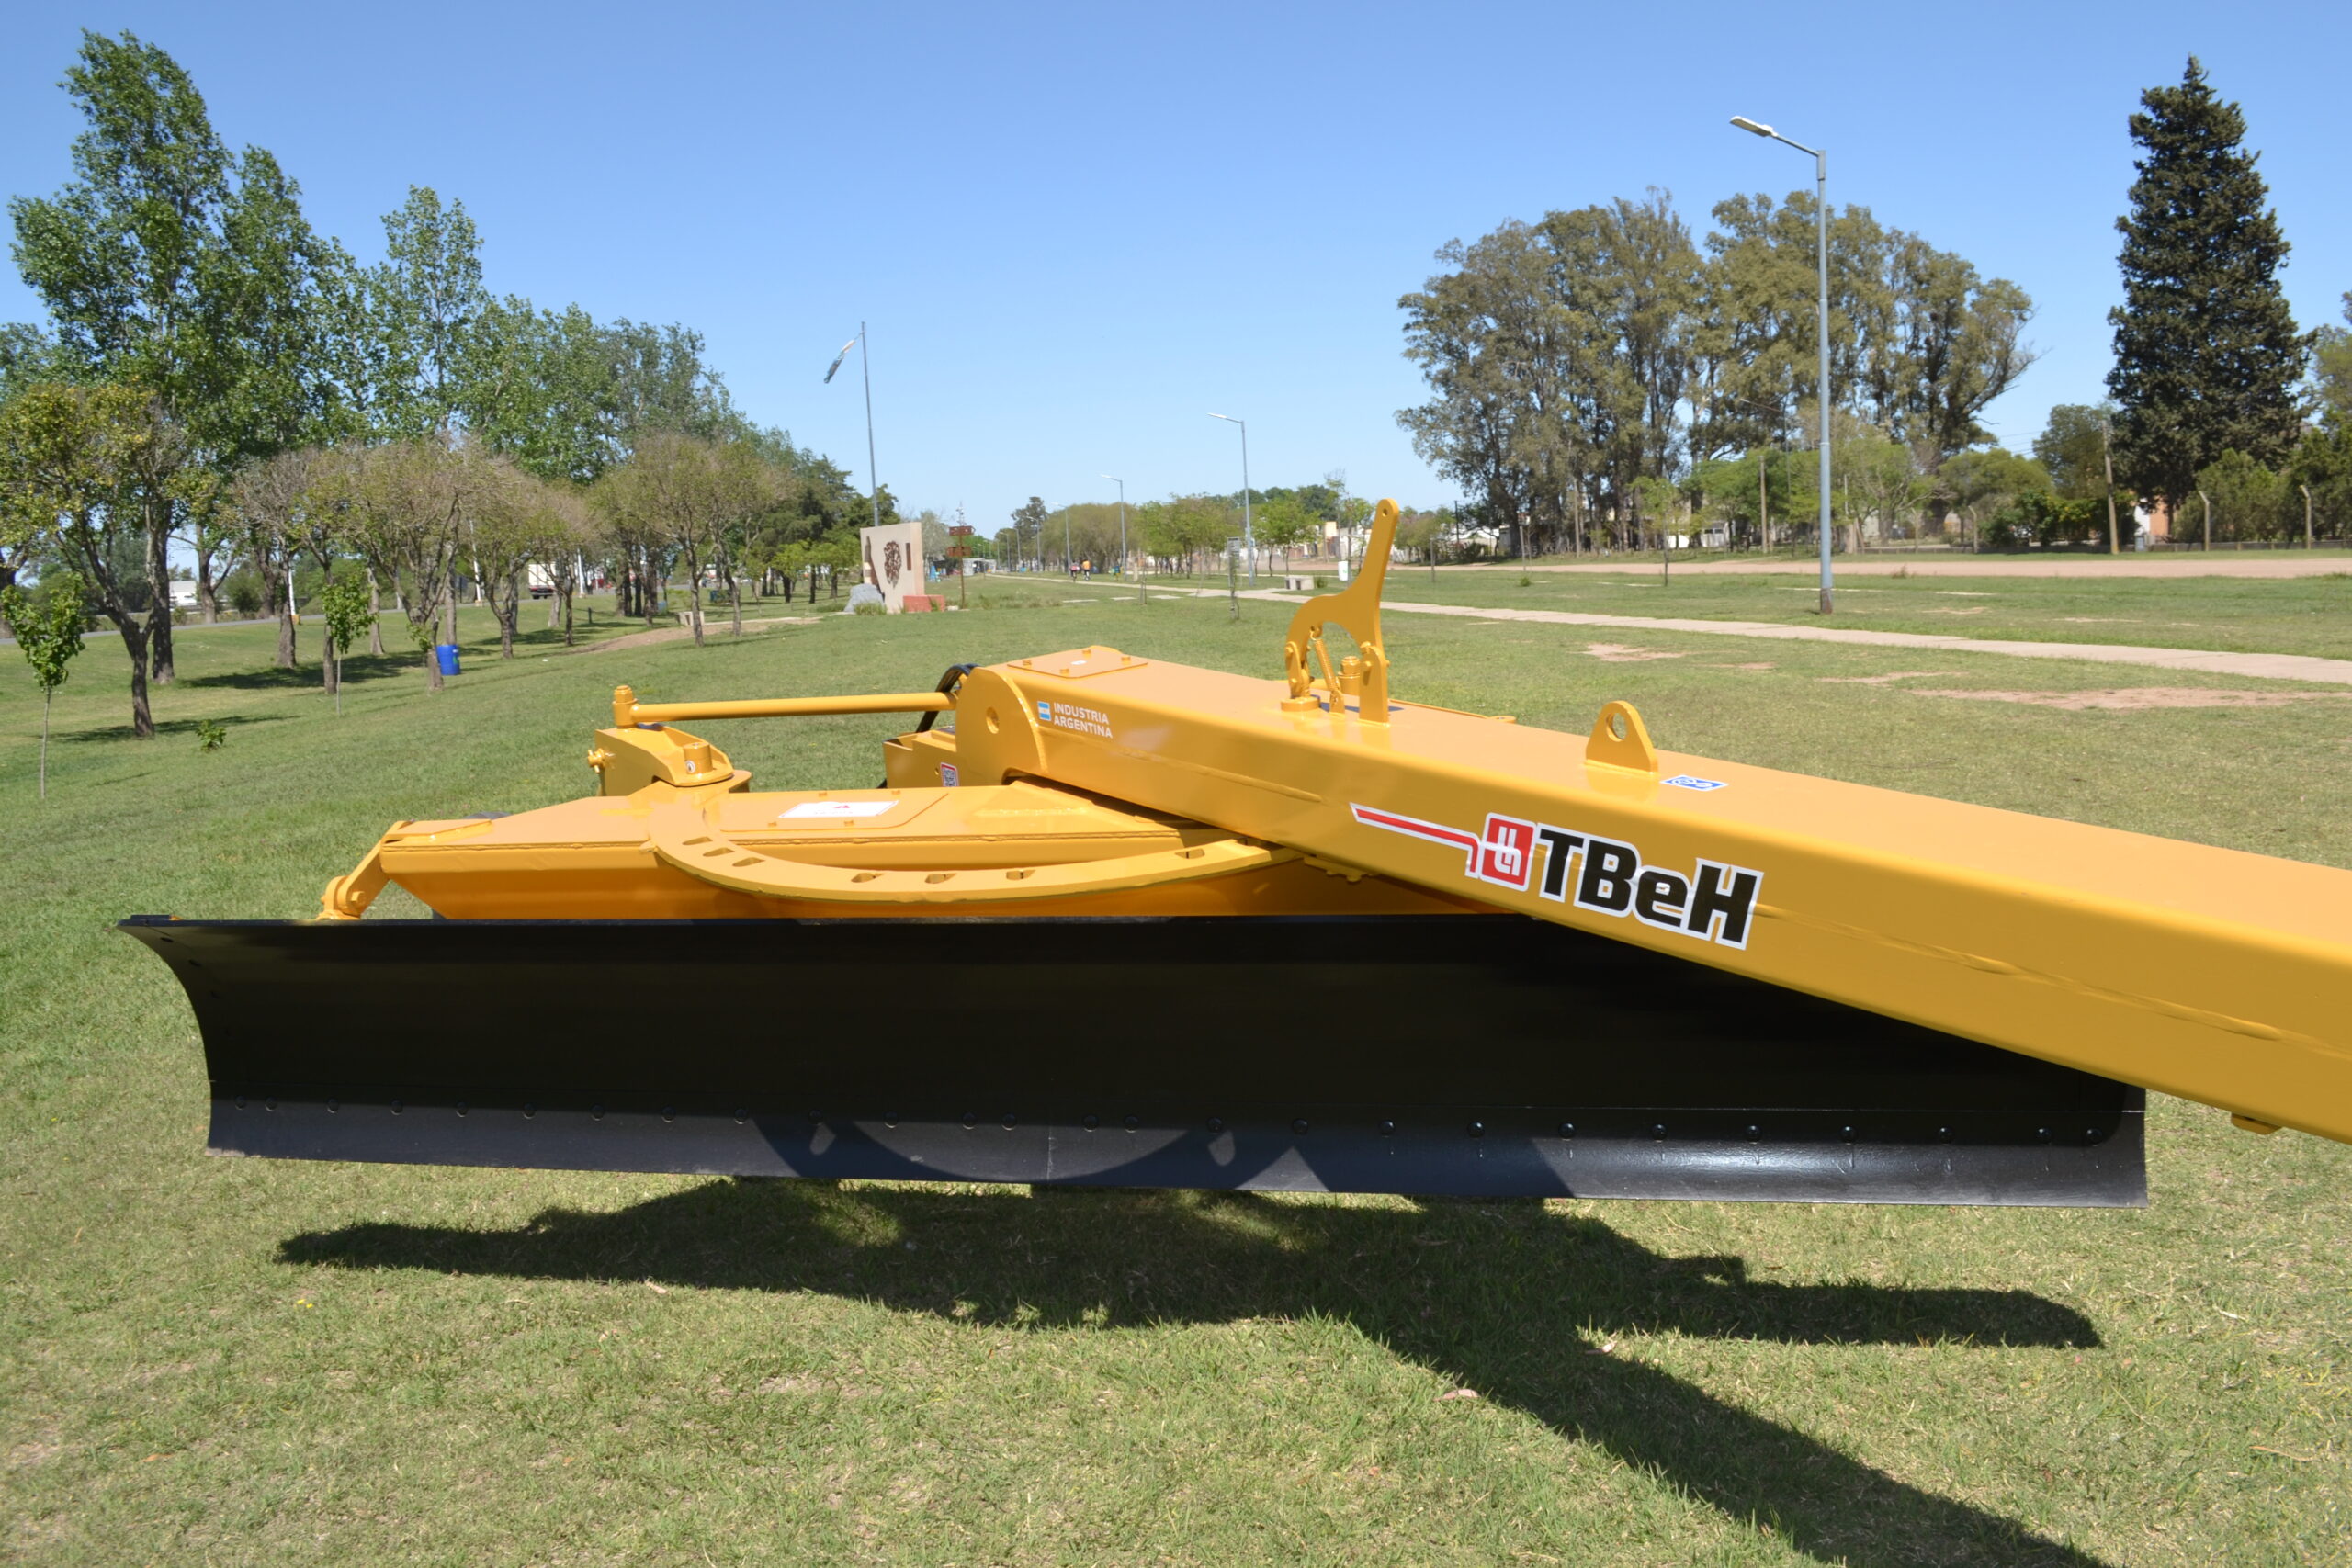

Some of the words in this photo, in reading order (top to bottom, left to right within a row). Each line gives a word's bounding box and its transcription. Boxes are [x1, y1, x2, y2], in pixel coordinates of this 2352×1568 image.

[1054, 703, 1110, 725] INDUSTRIA
[1054, 716, 1113, 738] ARGENTINA
[1538, 829, 1758, 944] TBeH
